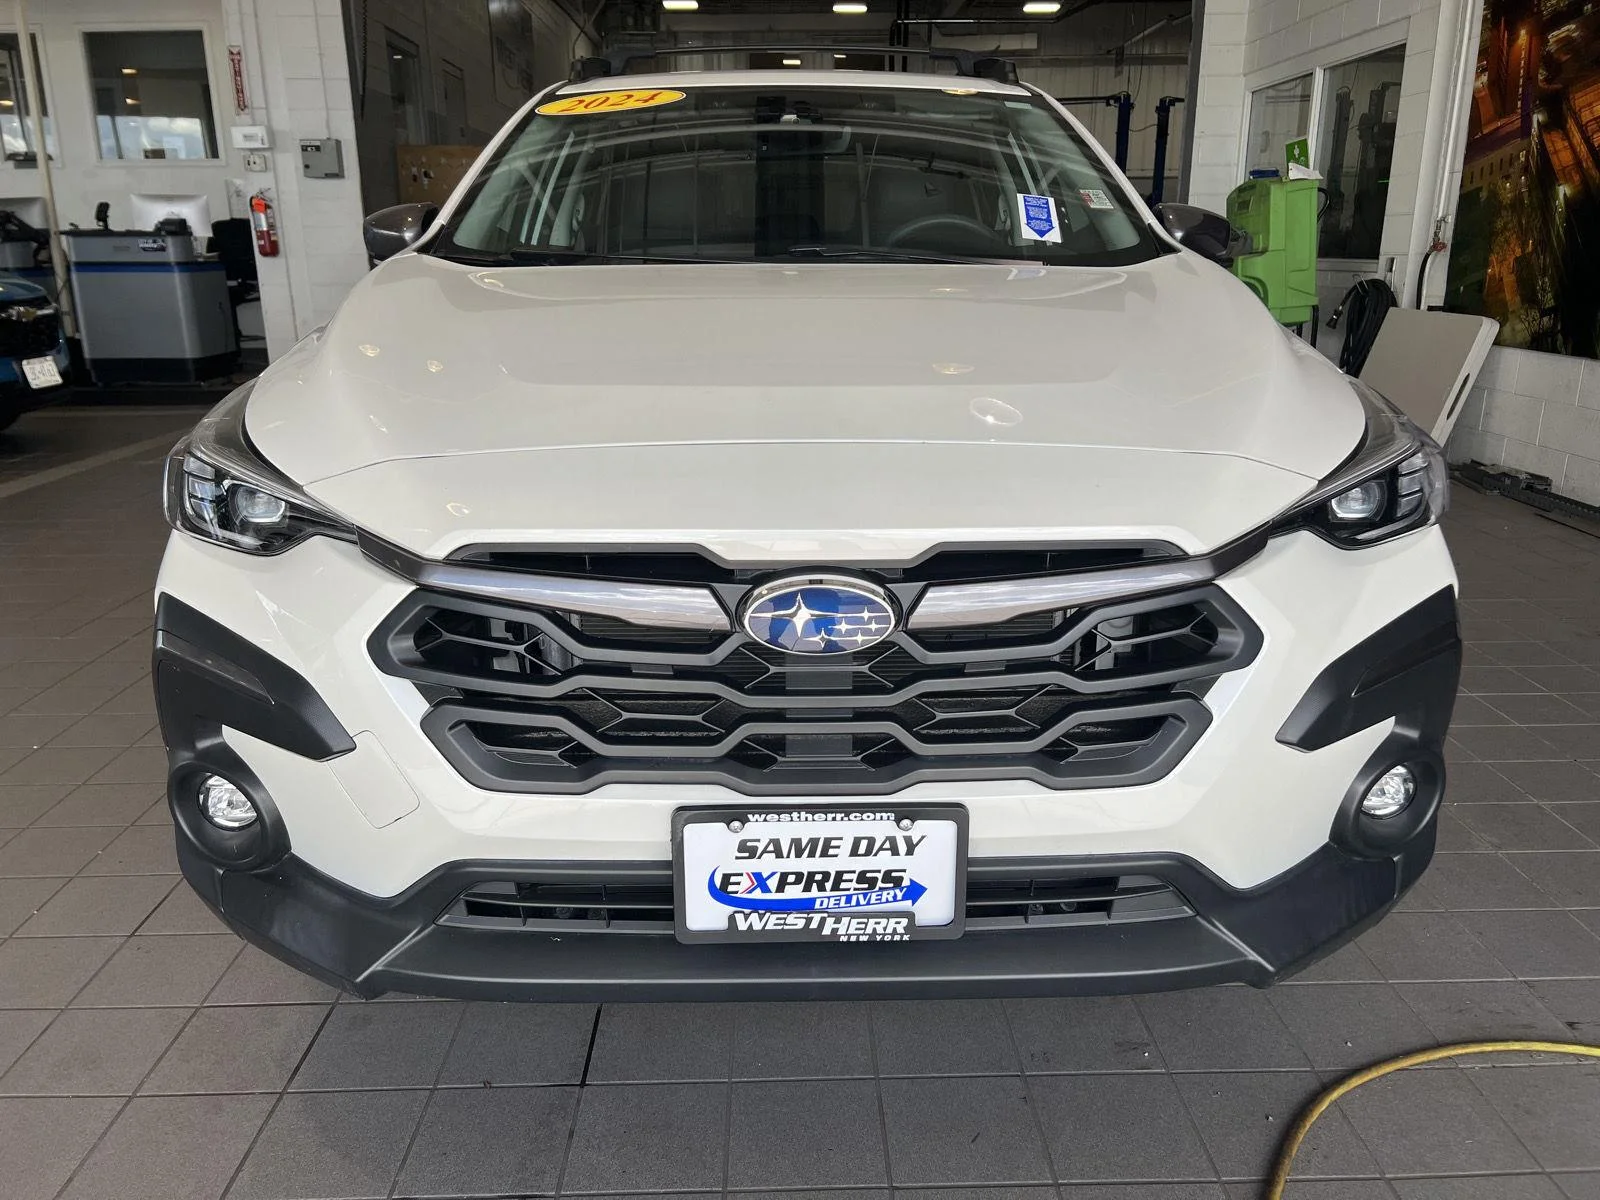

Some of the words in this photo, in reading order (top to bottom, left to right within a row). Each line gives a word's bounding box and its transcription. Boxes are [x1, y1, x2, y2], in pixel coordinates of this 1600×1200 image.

[557, 92, 663, 113] 2024
[747, 811, 895, 822] westherr.com
[735, 836, 844, 860] SAME
[848, 834, 928, 858] DAY
[719, 868, 907, 895] EXPRESS
[814, 888, 907, 910] DELIVERY
[876, 934, 911, 942] YORK
